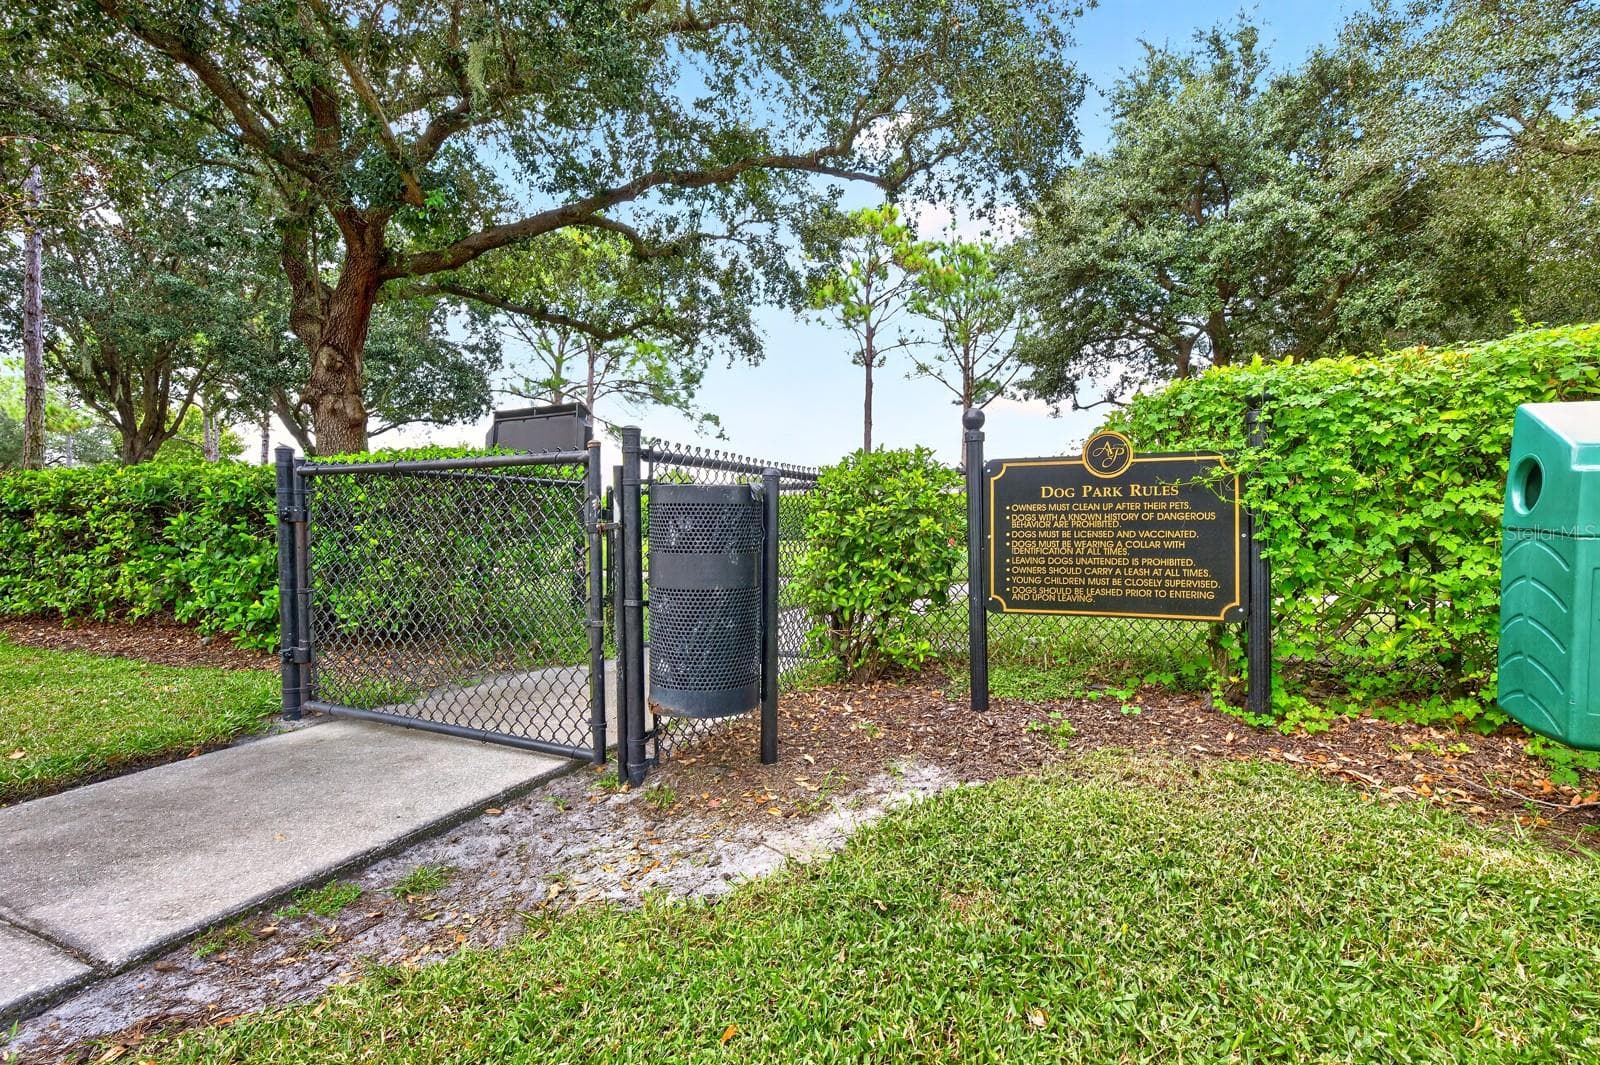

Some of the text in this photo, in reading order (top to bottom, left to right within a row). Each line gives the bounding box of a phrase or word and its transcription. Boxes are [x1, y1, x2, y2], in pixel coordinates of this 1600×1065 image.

[1165, 579, 1220, 588] SUPERVISED.
[1086, 588, 1122, 596] LEASHED
[1154, 590, 1167, 598] TO
[1169, 590, 1215, 599] ENTERING
[1057, 595, 1095, 603] LEAVING.
